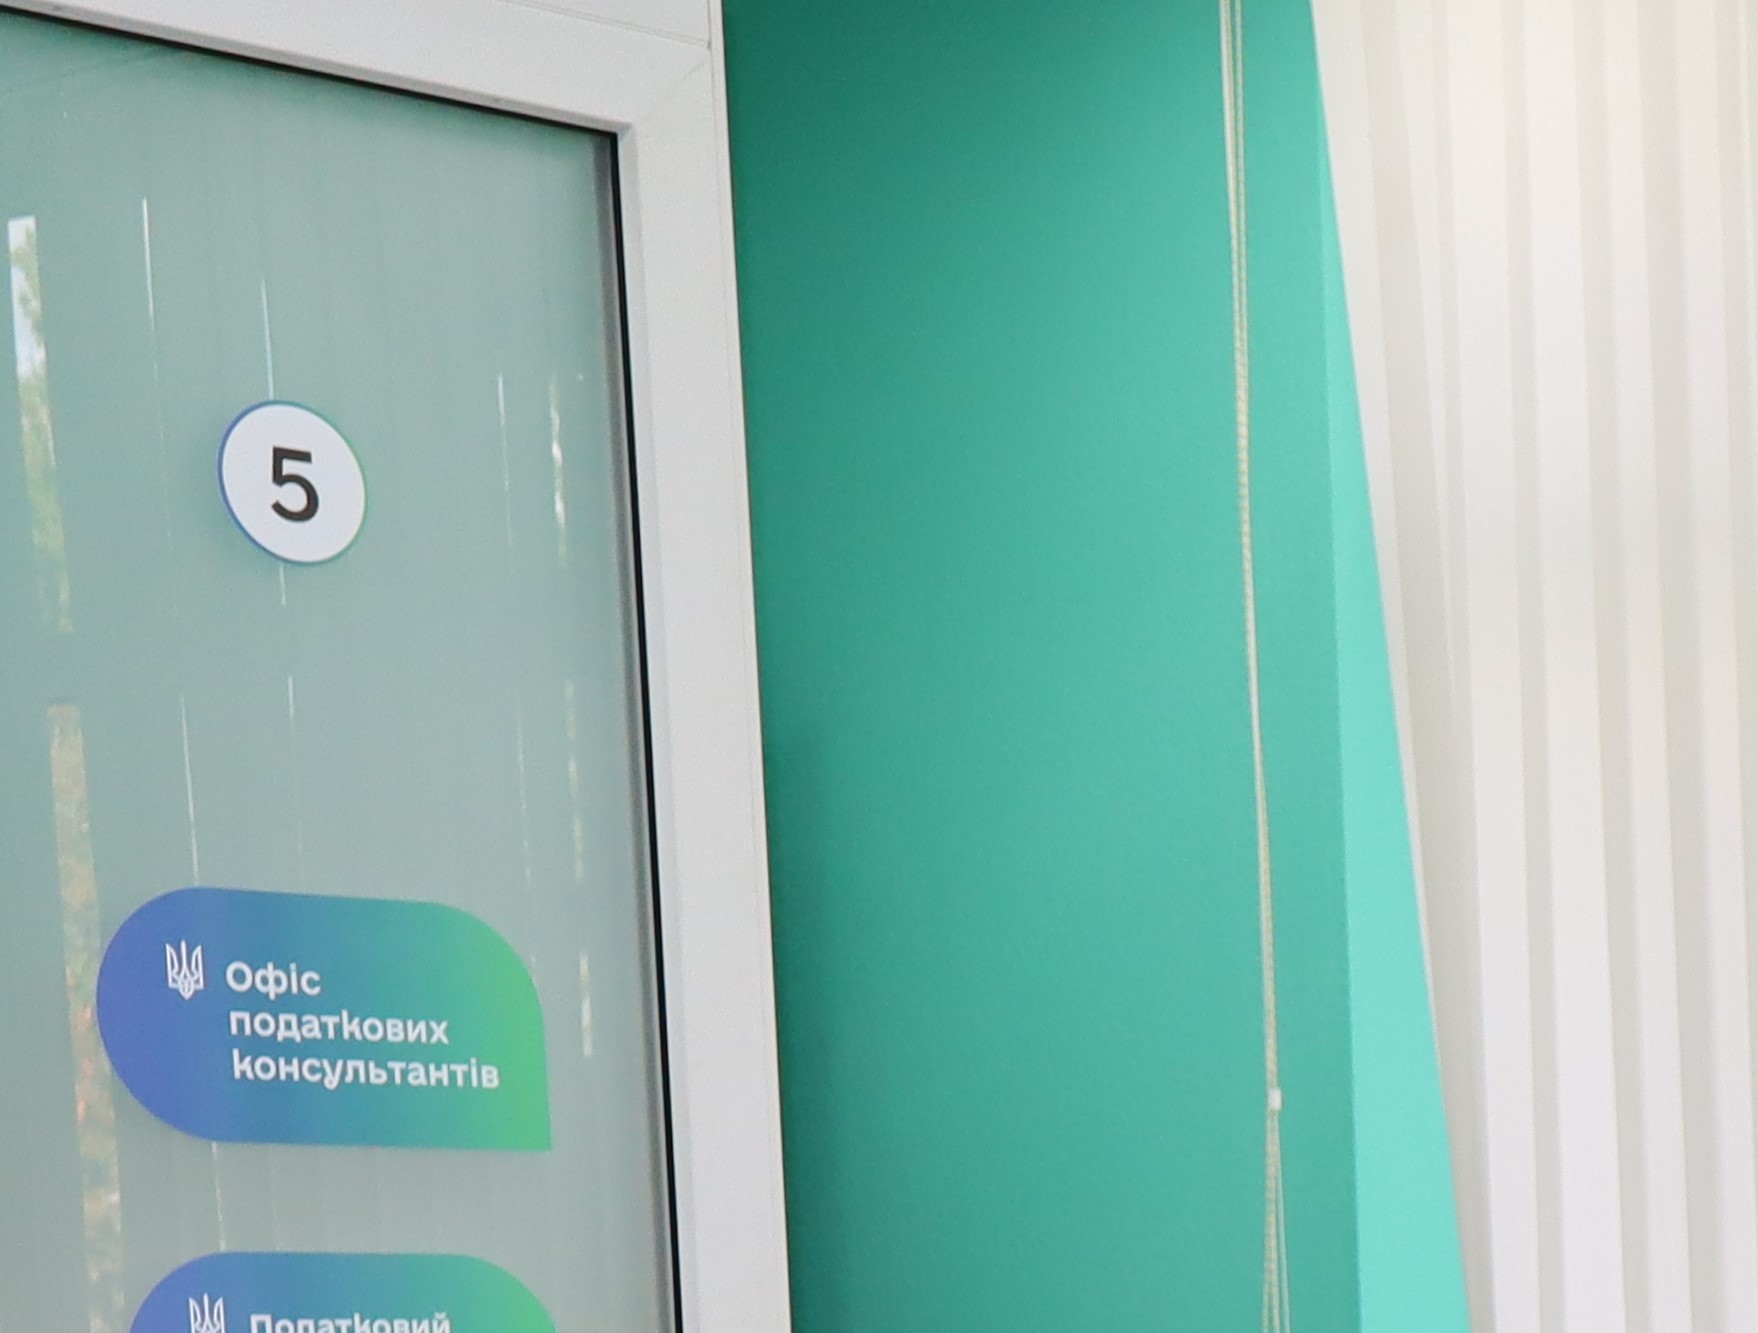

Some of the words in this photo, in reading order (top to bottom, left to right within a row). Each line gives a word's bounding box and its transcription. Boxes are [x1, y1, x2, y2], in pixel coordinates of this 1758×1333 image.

[271, 445, 319, 523] 5
[225, 961, 322, 1001] Офіс
[229, 1009, 450, 1045] податкових
[231, 1047, 502, 1091] консультантів
